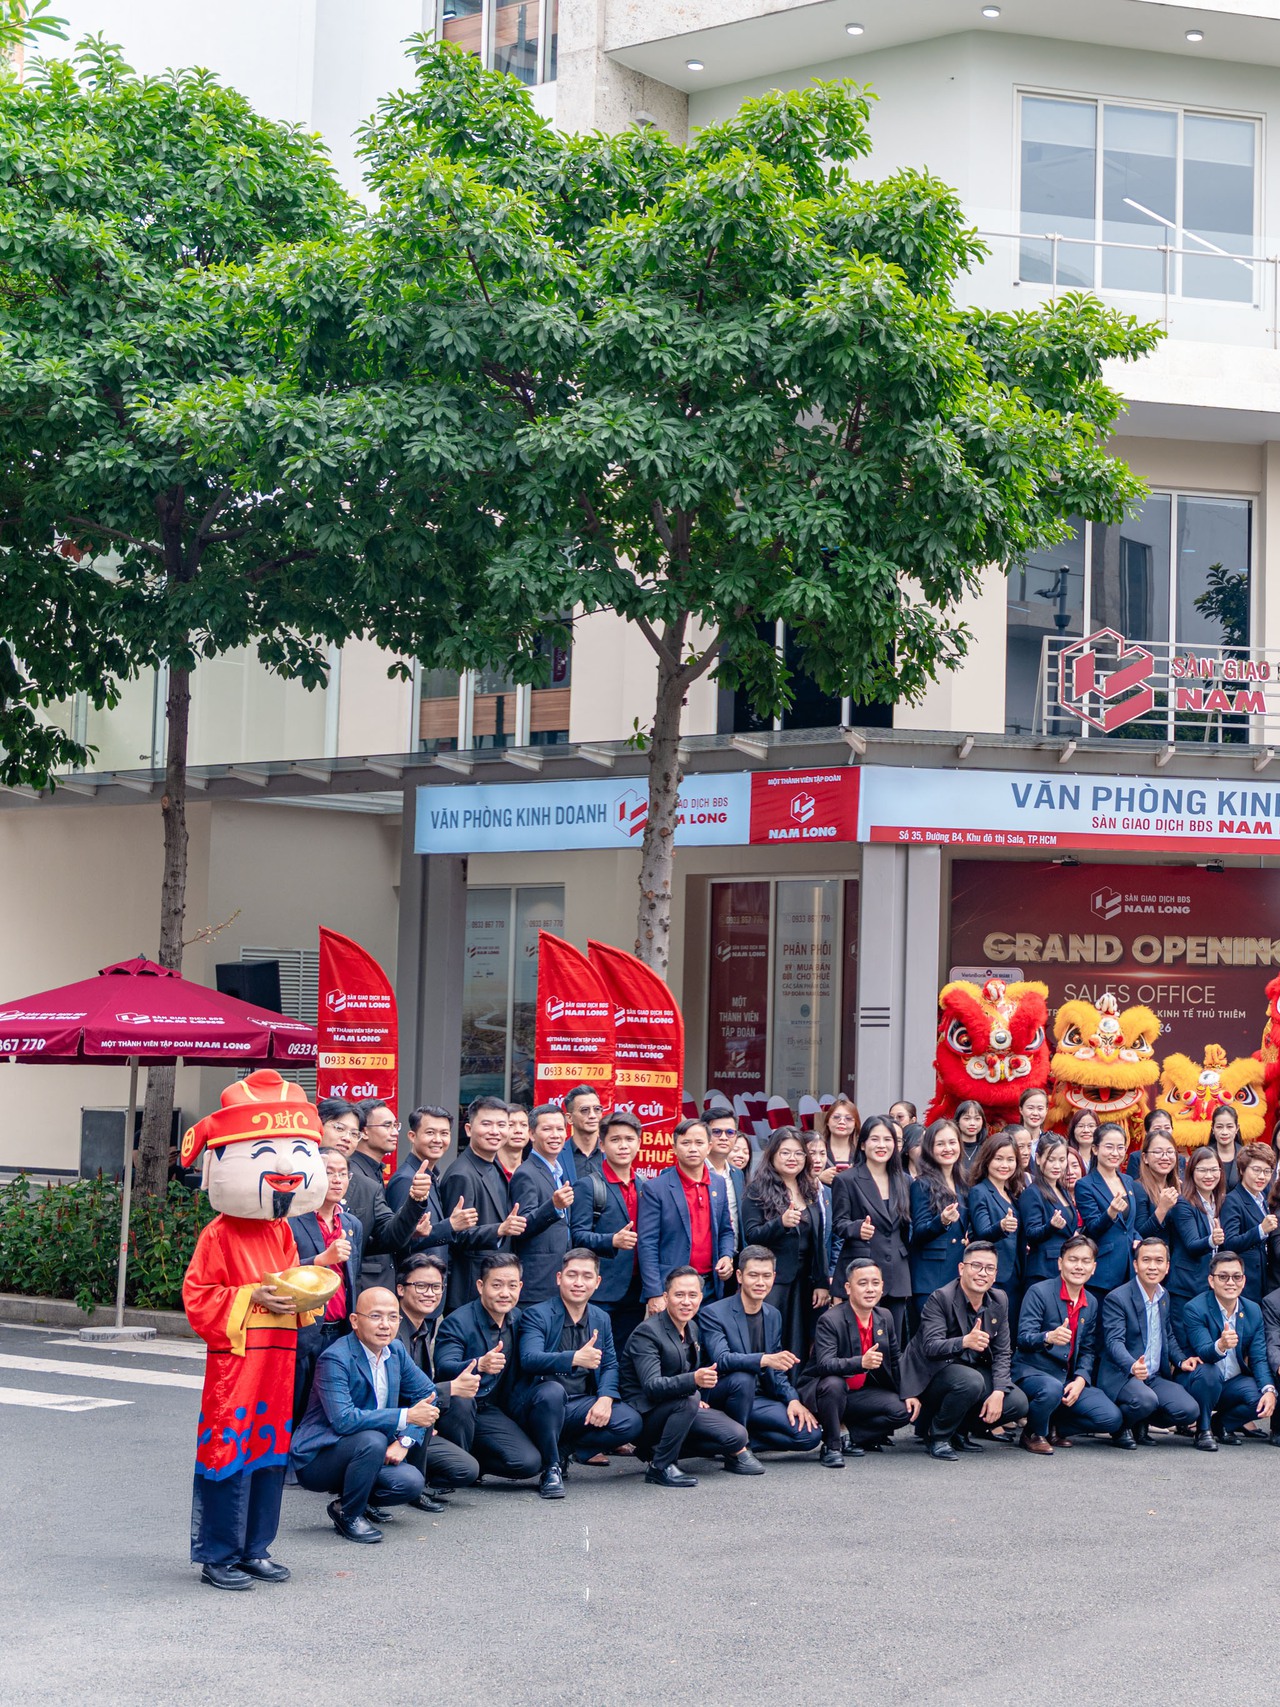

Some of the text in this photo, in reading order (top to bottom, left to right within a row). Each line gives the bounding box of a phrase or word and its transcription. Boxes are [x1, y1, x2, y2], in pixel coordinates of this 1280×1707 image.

[1172, 652, 1214, 679] SÀN
[1223, 659, 1270, 682] GIAO
[1176, 687, 1267, 714] NAM
[768, 774, 841, 786] MỘT THÀNH VIÊN TẬP ĐOÀN
[691, 798, 709, 810] DỊCH
[713, 797, 728, 806] BĐS
[1011, 780, 1080, 810] VĂN
[1092, 783, 1206, 815] PHÒNG
[431, 804, 607, 829] VĂN PHÒNG KINH DOANH
[690, 812, 728, 824] LONG
[1092, 814, 1116, 829] SÀN
[1122, 817, 1150, 830] GIAO
[1156, 819, 1183, 833] DỊCH
[1189, 820, 1212, 832] BĐS
[1219, 820, 1272, 834] NAM
[769, 826, 837, 839] NAM LONG
[899, 830, 909, 839] Số
[911, 831, 923, 840] 35,
[926, 831, 949, 842] Đường
[952, 832, 964, 842] B4,
[967, 832, 980, 842] Khu
[995, 834, 1005, 844] thị
[1007, 834, 1025, 845] Sala,
[1125, 893, 1138, 902] SÀN
[1159, 896, 1174, 904] DỊCH
[1125, 905, 1190, 914] NAM LONG
[783, 942, 807, 955] PHÂN
[983, 932, 1124, 964] GRAND
[1064, 984, 1216, 1004] SALES OFFICE
[732, 995, 747, 1009] MỘT
[719, 1010, 759, 1022] THÀNH VIÊN
[1157, 1007, 1246, 1019] KINH TẾ THỦ THIÊM
[333, 1034, 355, 1042] NAM
[722, 1026, 756, 1039] TẬP ĐOÀN
[22, 1038, 46, 1051] 770
[101, 1040, 116, 1048] MỘT
[118, 1039, 142, 1047] THÀNH
[144, 1039, 158, 1047] VIÊN
[160, 1040, 172, 1049] TẬP
[223, 1042, 251, 1050] LONG
[288, 1043, 311, 1055] 0933
[324, 1056, 388, 1065] 0933 867 770
[565, 1067, 582, 1076] 867
[587, 1067, 604, 1076] 770
[714, 1071, 761, 1079] NAM LONG
[634, 1074, 671, 1083] 867 770
[330, 1082, 378, 1097] KÝ GỬI
[614, 1101, 663, 1116] KÝ GỬI
[276, 1111, 292, 1129] 财
[643, 1130, 674, 1146] BÁN
[637, 1148, 674, 1163] THUÊ
